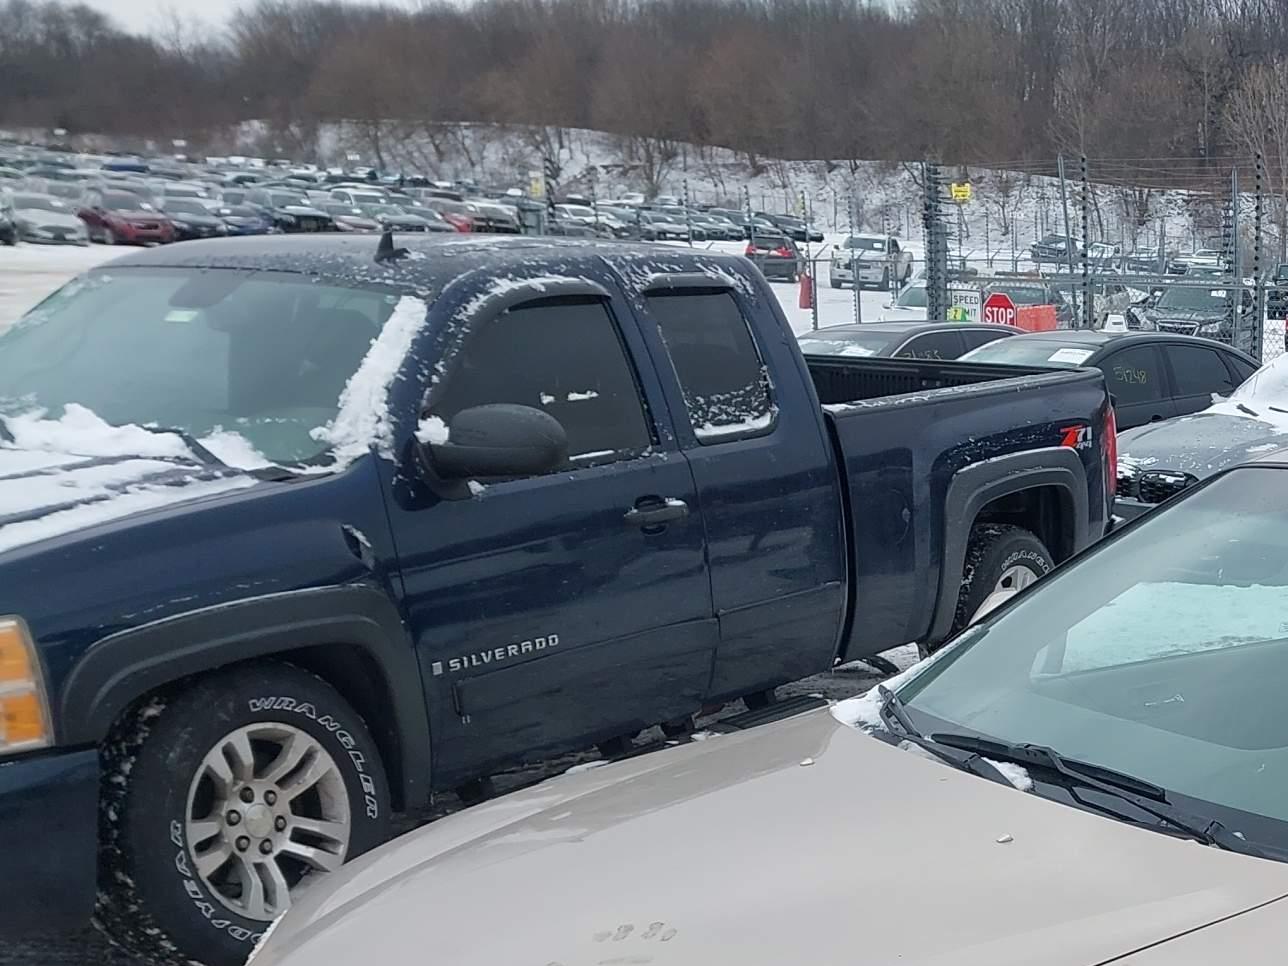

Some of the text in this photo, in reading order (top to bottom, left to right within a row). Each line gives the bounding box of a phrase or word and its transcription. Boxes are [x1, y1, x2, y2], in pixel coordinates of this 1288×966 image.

[953, 295, 979, 305] SPEED
[985, 306, 1015, 325] STOP
[449, 634, 559, 672] SILVERADO
[248, 696, 378, 819] WRANGLER
